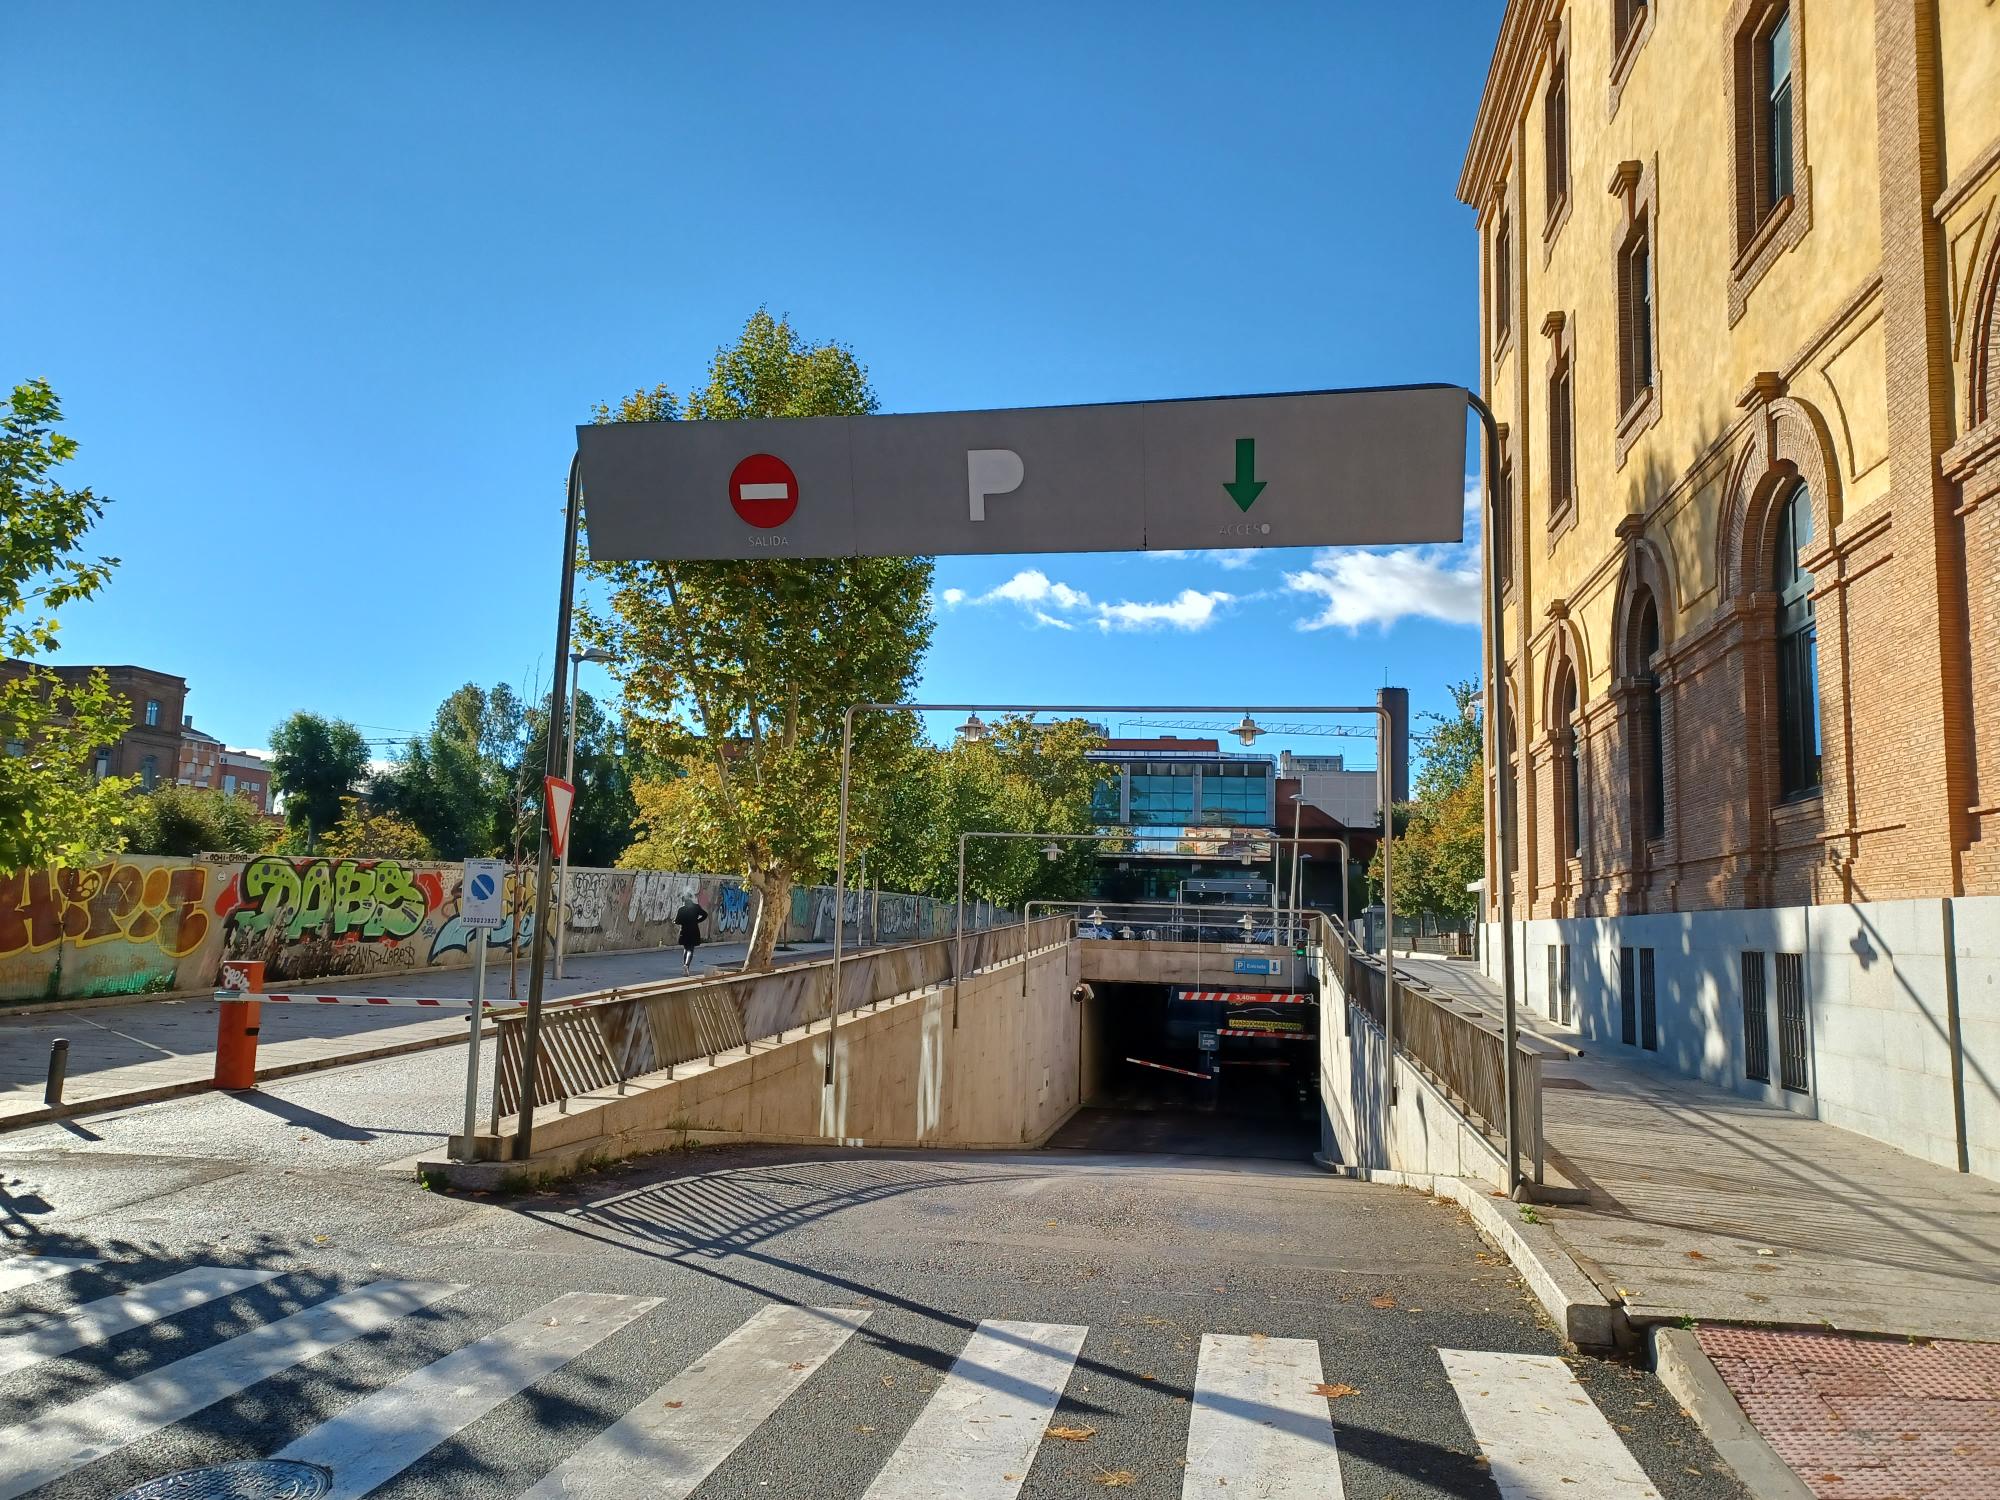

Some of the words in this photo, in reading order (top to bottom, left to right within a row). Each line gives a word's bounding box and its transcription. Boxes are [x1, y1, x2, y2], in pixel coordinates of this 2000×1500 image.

[967, 448, 1025, 521] P
[1219, 523, 1271, 536] ACCESO
[748, 535, 789, 547] SALIDA
